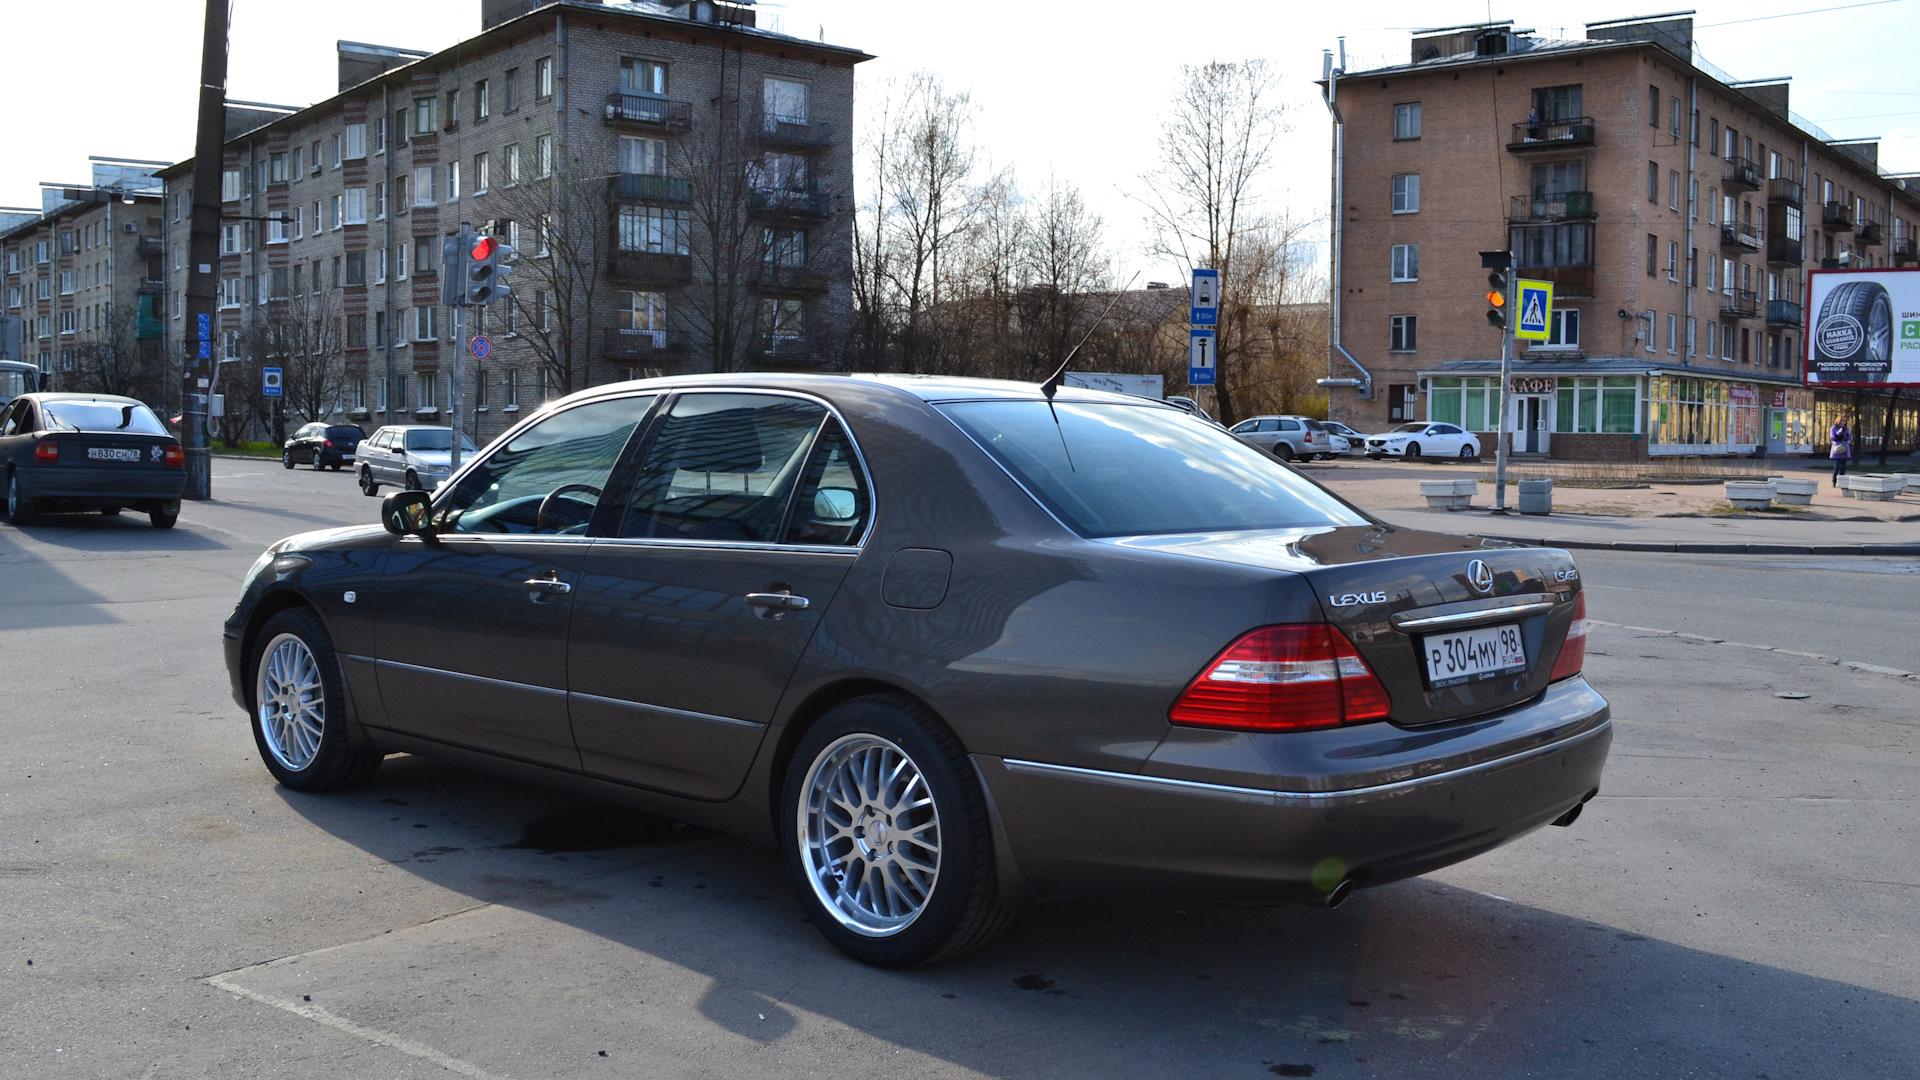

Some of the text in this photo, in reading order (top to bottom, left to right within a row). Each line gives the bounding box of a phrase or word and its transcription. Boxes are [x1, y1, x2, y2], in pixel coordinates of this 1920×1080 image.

[1826, 328, 1853, 339] HAKKA
[1509, 378, 1553, 393] КАФЕ
[1329, 591, 1387, 607] LEXUS
